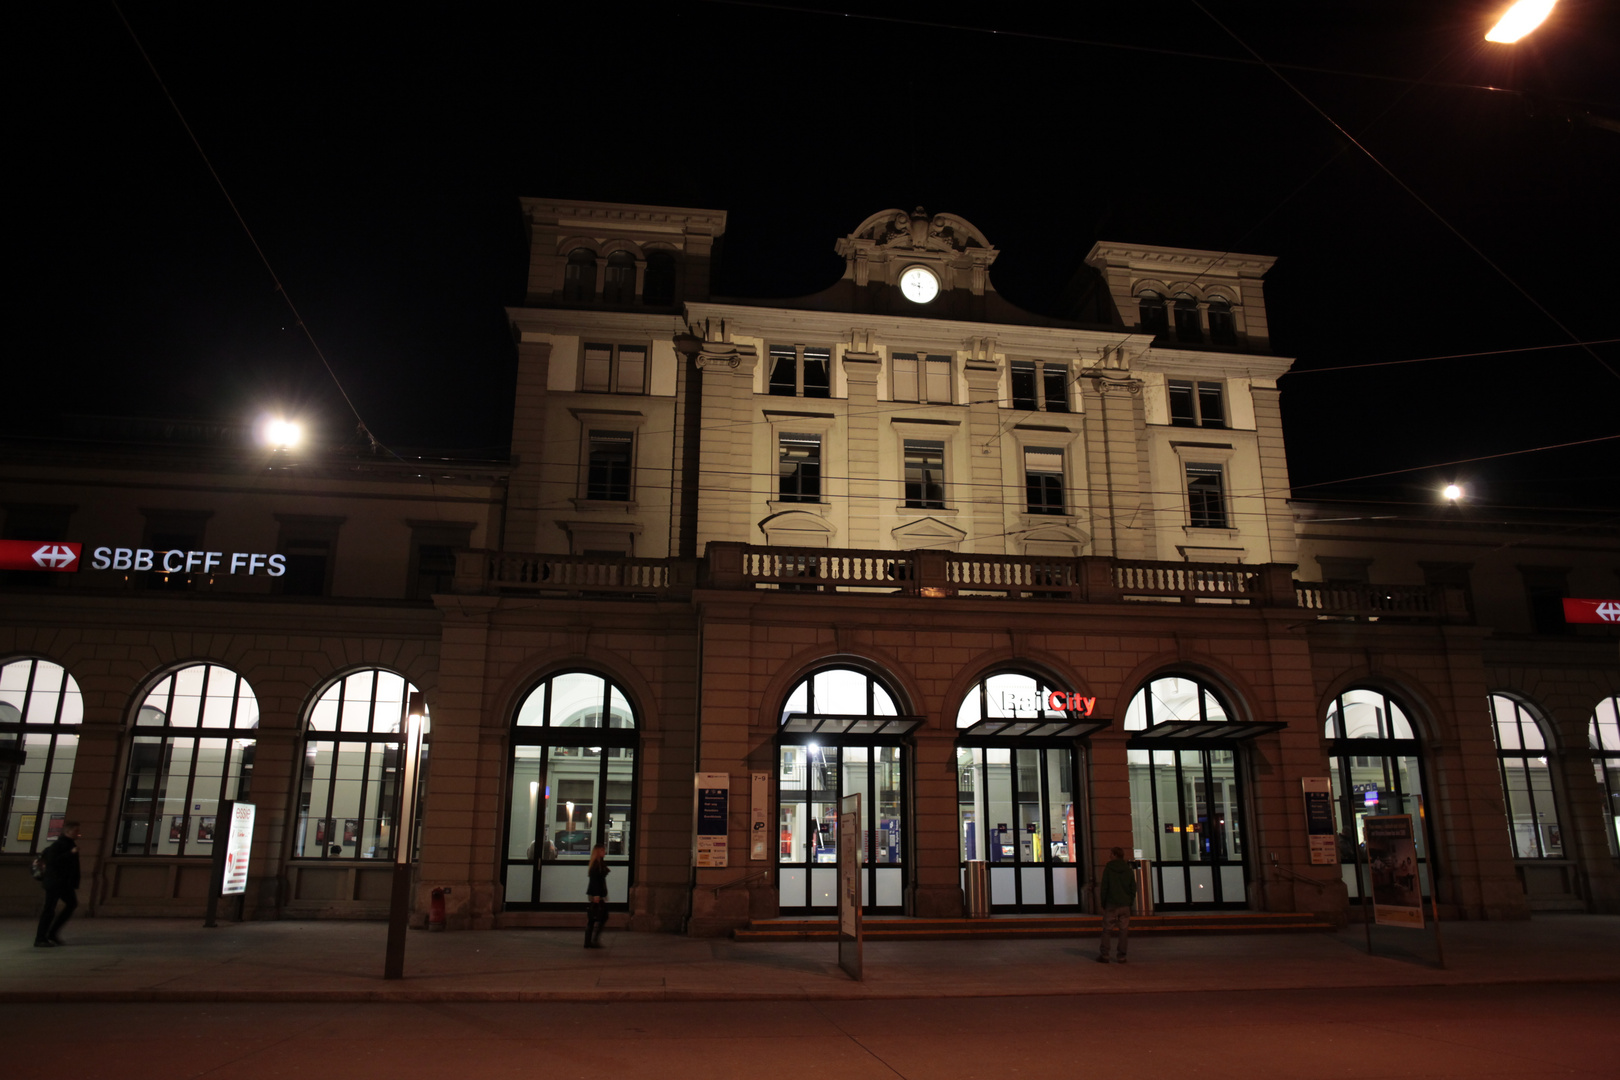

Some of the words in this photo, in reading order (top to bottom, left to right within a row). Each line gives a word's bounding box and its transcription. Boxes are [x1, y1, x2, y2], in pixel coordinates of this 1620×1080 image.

[91, 546, 154, 571] SBB
[162, 549, 223, 573] CFF
[230, 552, 287, 577] FFS
[235, 808, 251, 820] essie
